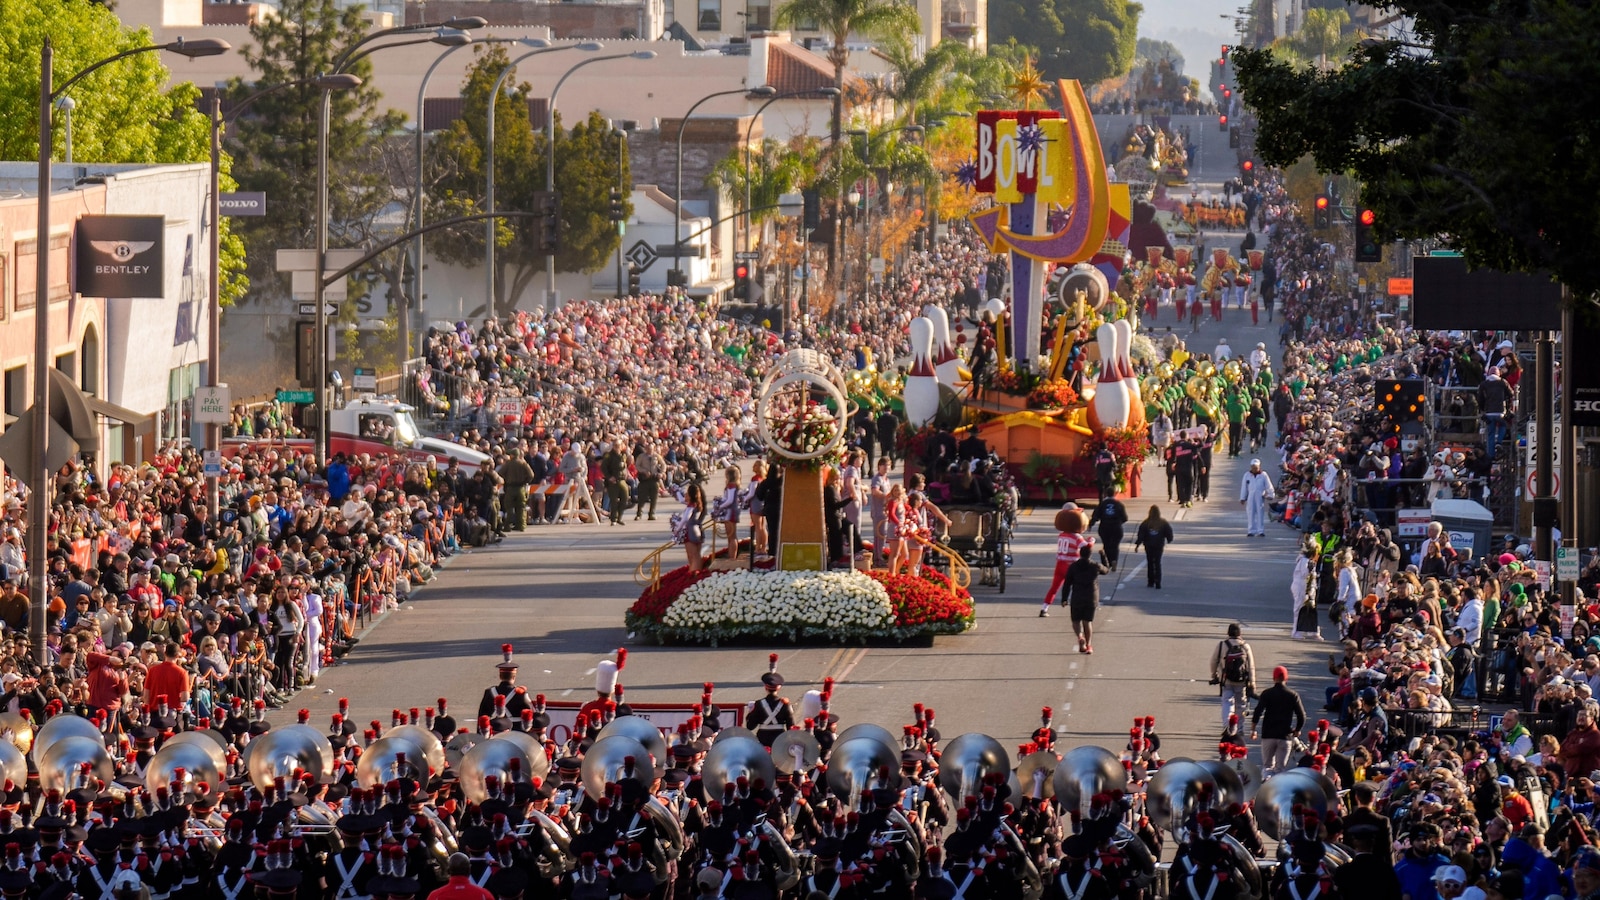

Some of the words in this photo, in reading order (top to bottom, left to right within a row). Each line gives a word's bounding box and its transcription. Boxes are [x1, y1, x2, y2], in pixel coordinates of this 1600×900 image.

[979, 122, 1054, 189] BOWL
[219, 200, 259, 208] VOLVO
[95, 265, 150, 274] BENTLEY
[279, 392, 287, 401] St
[289, 392, 305, 401] John
[201, 405, 224, 413] HERE
[500, 402, 517, 411] 235
[1451, 535, 1473, 543] United
[1058, 538, 1069, 555] 00
[1559, 549, 1565, 557] 2
